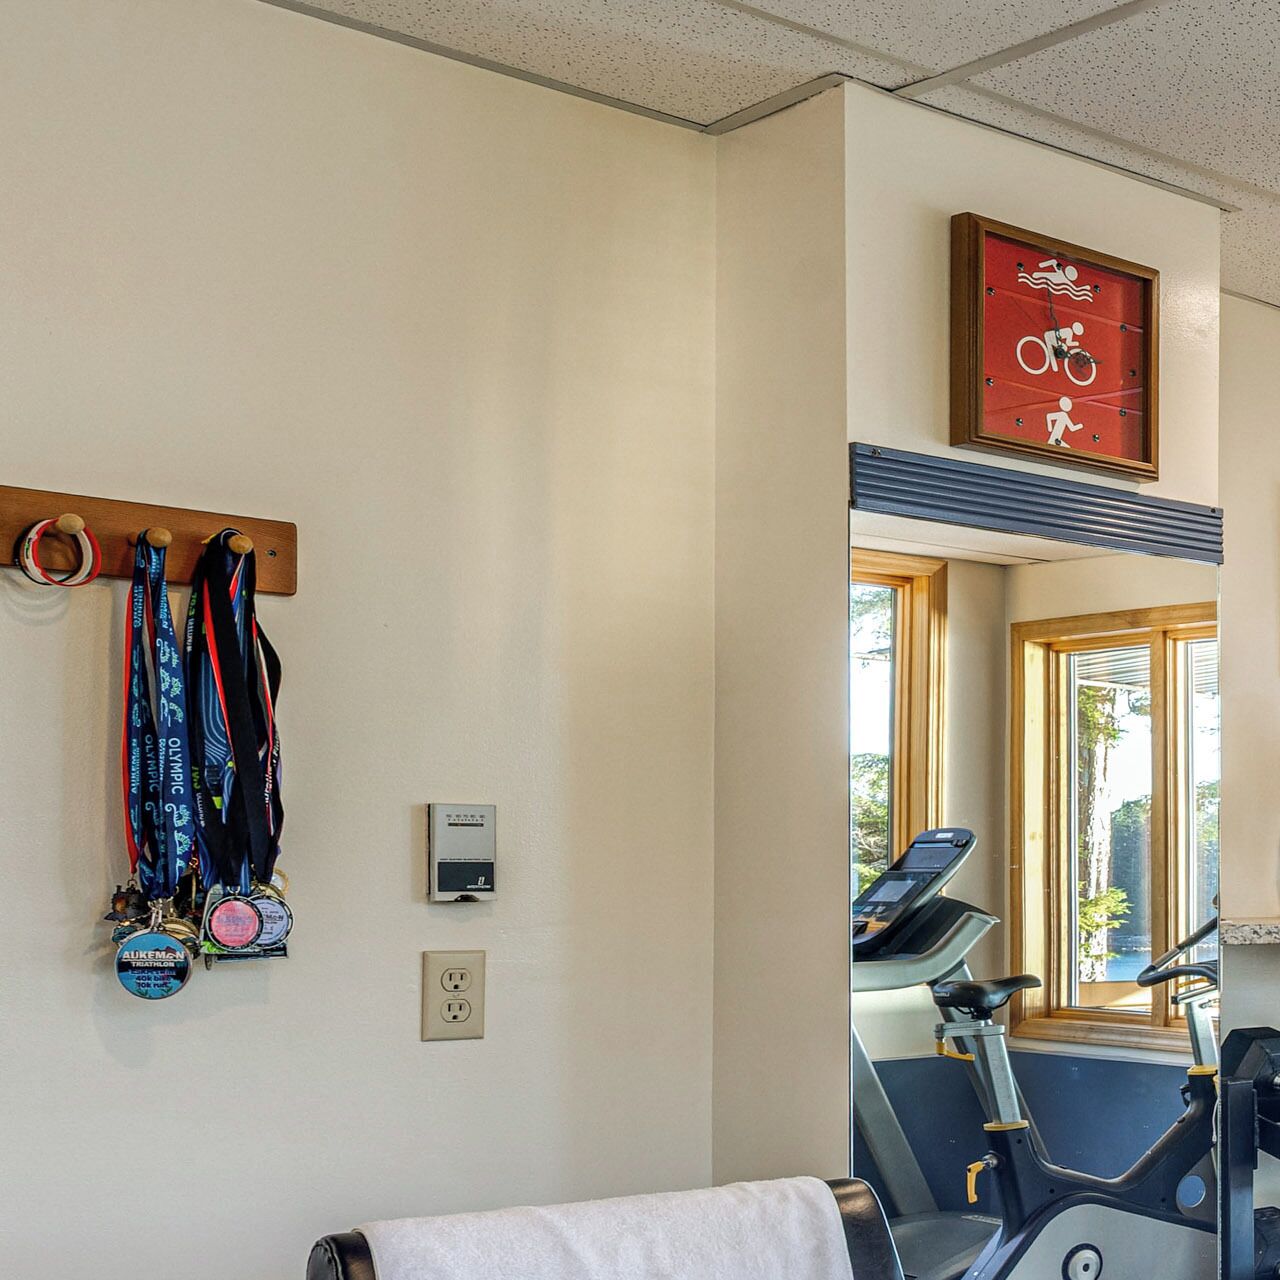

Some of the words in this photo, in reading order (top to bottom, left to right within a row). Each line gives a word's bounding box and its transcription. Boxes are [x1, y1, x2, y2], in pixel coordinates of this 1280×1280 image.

[145, 734, 160, 793] OLYMPIC
[168, 737, 184, 795] OLYMPIC
[131, 960, 175, 968] TRIATHLON
